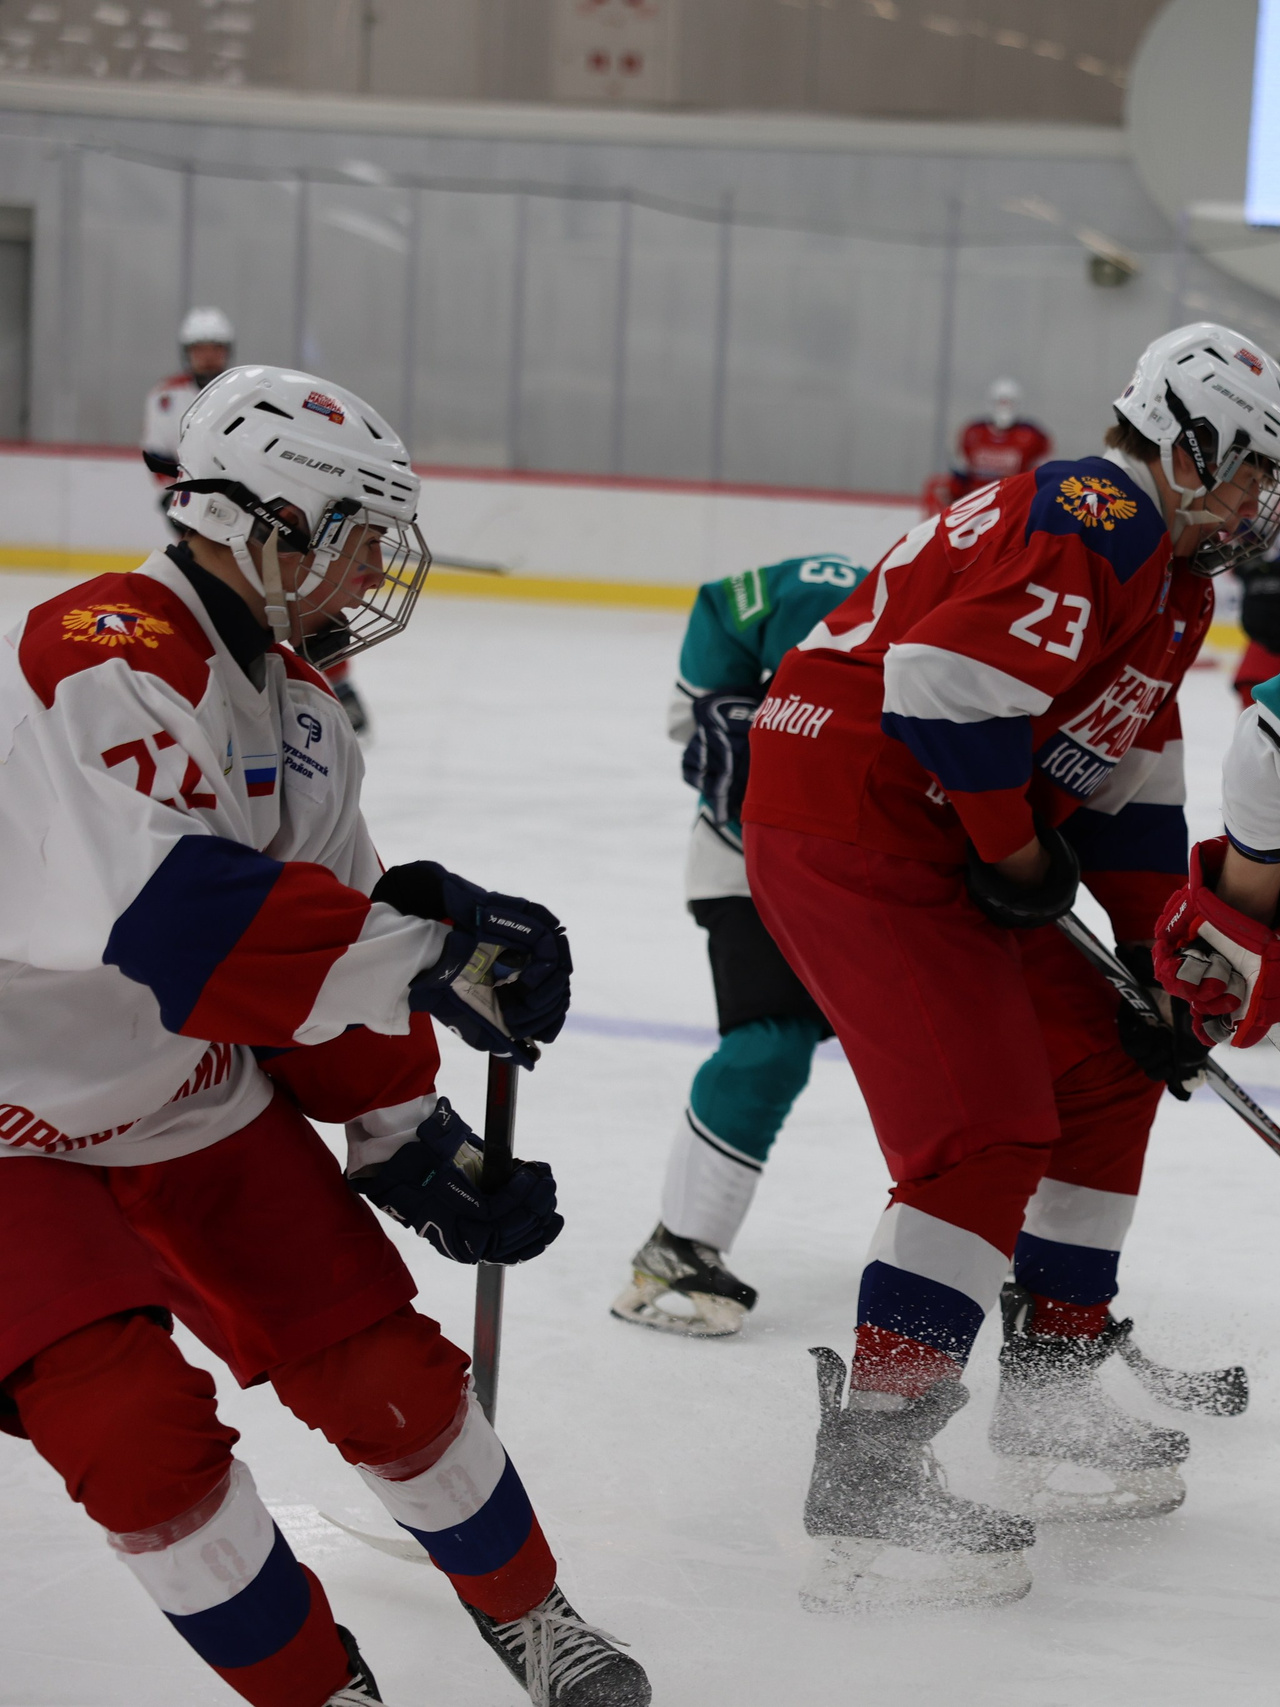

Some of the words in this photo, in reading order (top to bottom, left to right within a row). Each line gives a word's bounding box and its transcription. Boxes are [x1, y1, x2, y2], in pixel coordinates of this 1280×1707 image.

[1211, 384, 1255, 414] BAUER
[279, 450, 346, 477] BAUER
[1185, 429, 1206, 468] SOYUZ
[1008, 582, 1092, 662] 23
[758, 694, 834, 739] РАЙОН
[101, 730, 217, 810] 72
[285, 756, 314, 779] Район
[1105, 976, 1151, 1011] ACE
